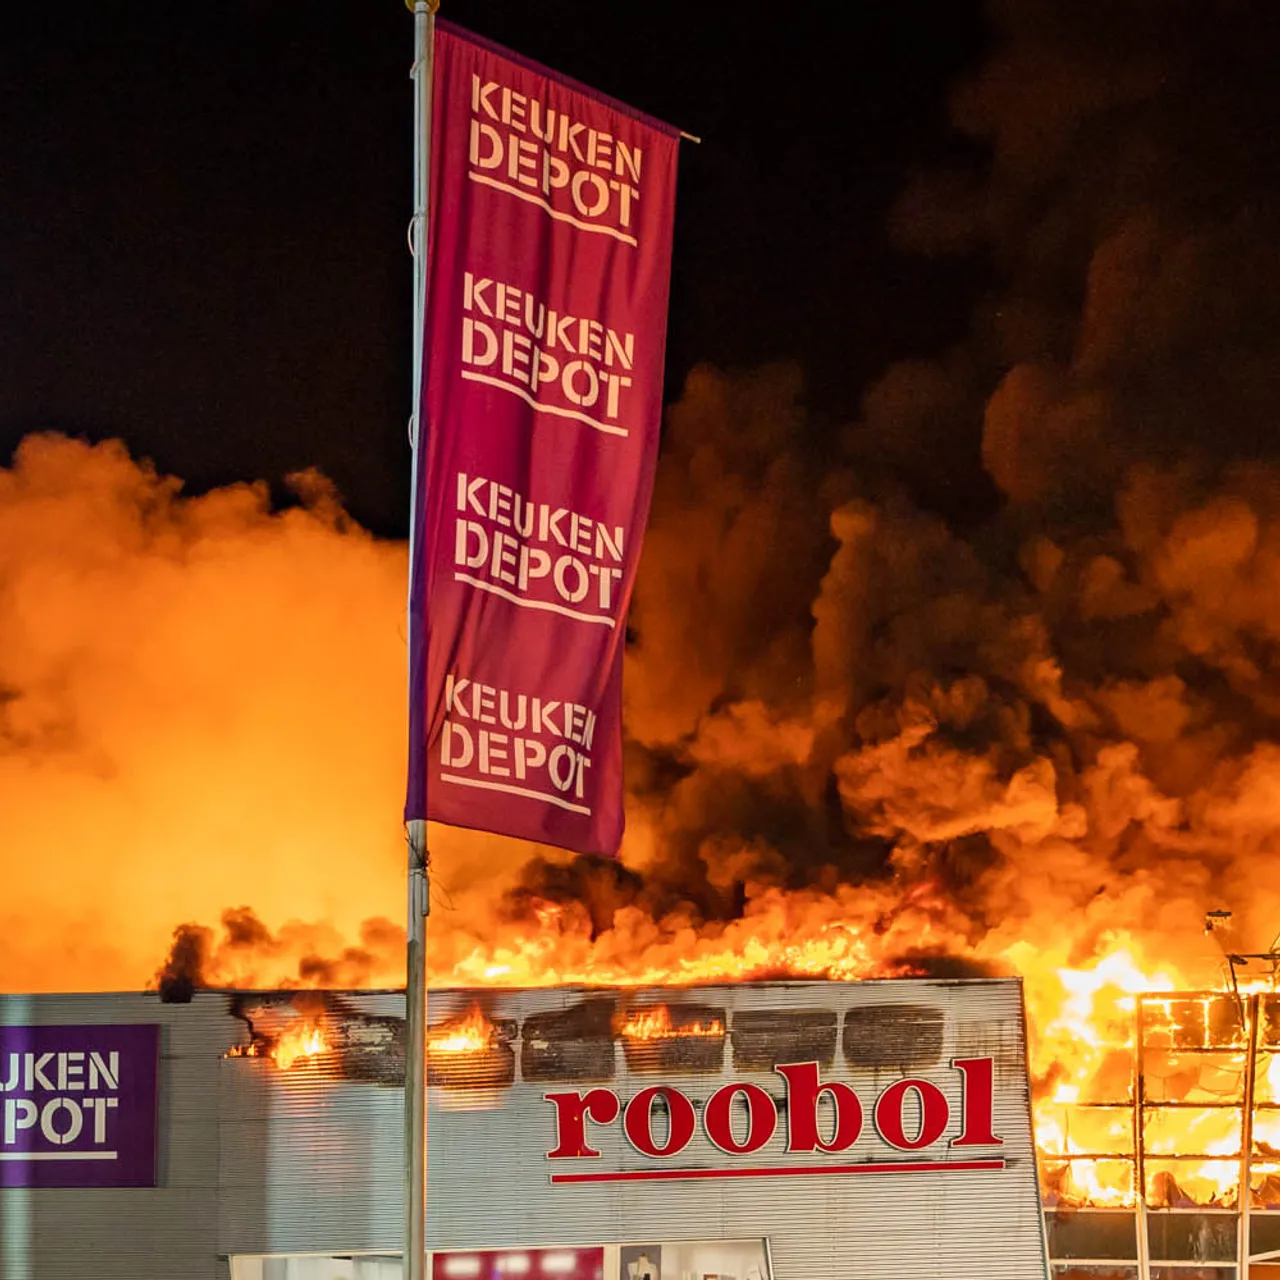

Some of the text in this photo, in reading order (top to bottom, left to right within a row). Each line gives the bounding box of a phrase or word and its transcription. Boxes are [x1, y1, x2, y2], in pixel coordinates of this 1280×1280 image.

[470, 119, 640, 227] DEPOT
[471, 73, 642, 184] KEUKEN
[461, 317, 632, 419] DEPOT
[463, 271, 634, 370] KEUKEN
[455, 518, 622, 610] DEPOT
[456, 472, 624, 562] KEUKEN
[440, 720, 592, 799] DEPOT
[445, 674, 597, 751] KEUKEN
[544, 1056, 1005, 1159] roobol
